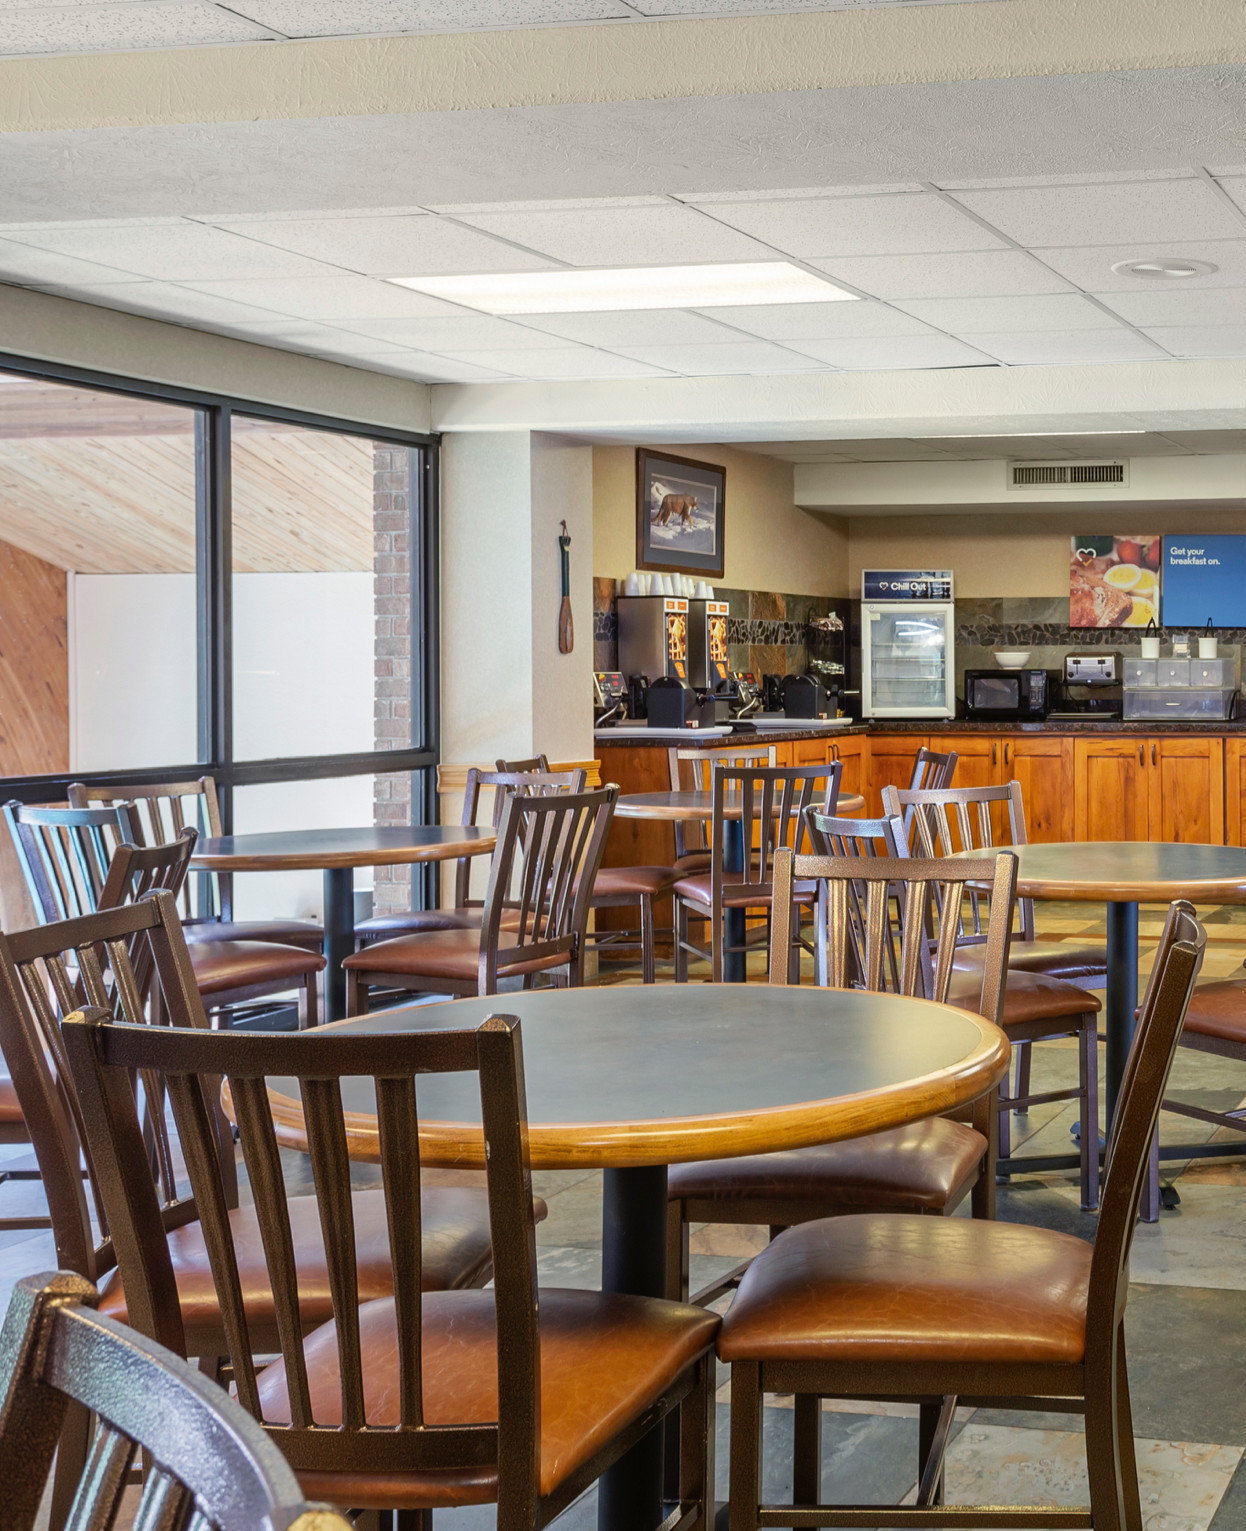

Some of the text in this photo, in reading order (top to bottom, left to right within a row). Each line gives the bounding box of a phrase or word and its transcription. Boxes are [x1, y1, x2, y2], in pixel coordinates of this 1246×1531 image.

[1170, 546, 1205, 557] Get your
[1170, 557, 1207, 565] breakfast
[890, 582, 927, 591] Chill Out
